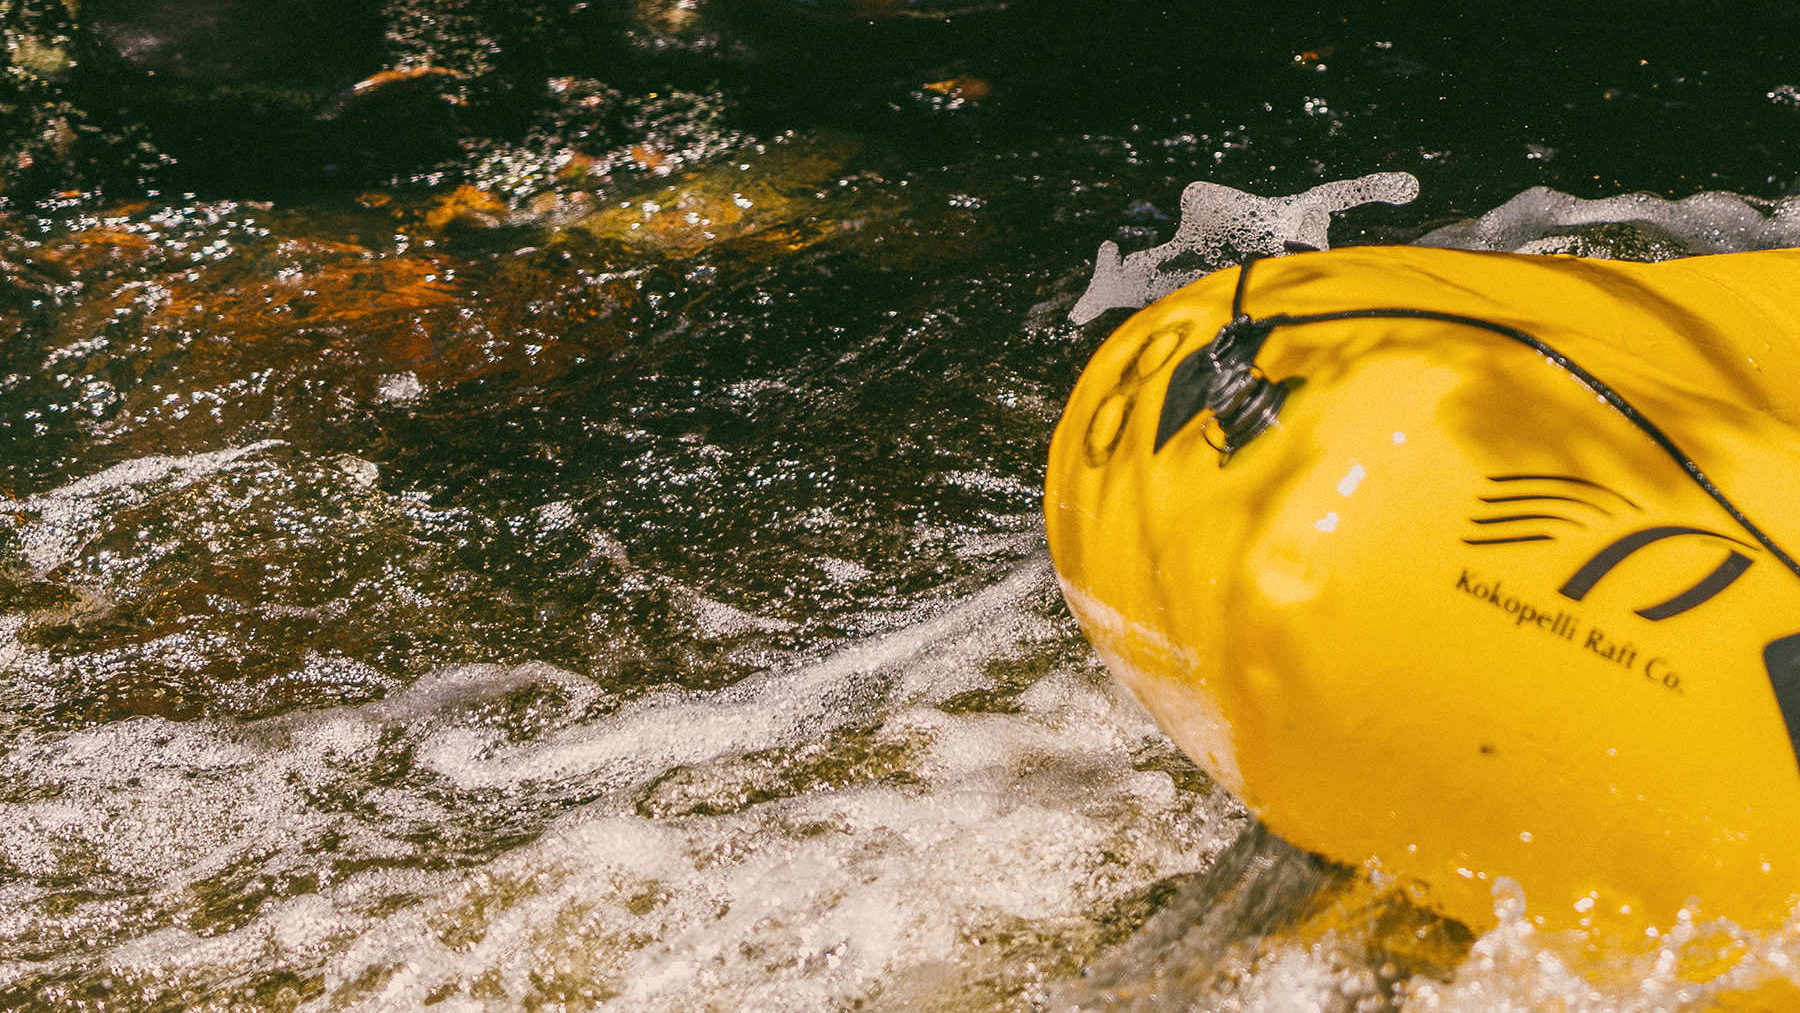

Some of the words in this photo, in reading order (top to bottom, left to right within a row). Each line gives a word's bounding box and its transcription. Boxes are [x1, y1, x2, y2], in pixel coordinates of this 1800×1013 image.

[1456, 570, 1580, 641] Kokopelli
[1584, 626, 1637, 668] Raft
[1644, 656, 1685, 695] Co.
